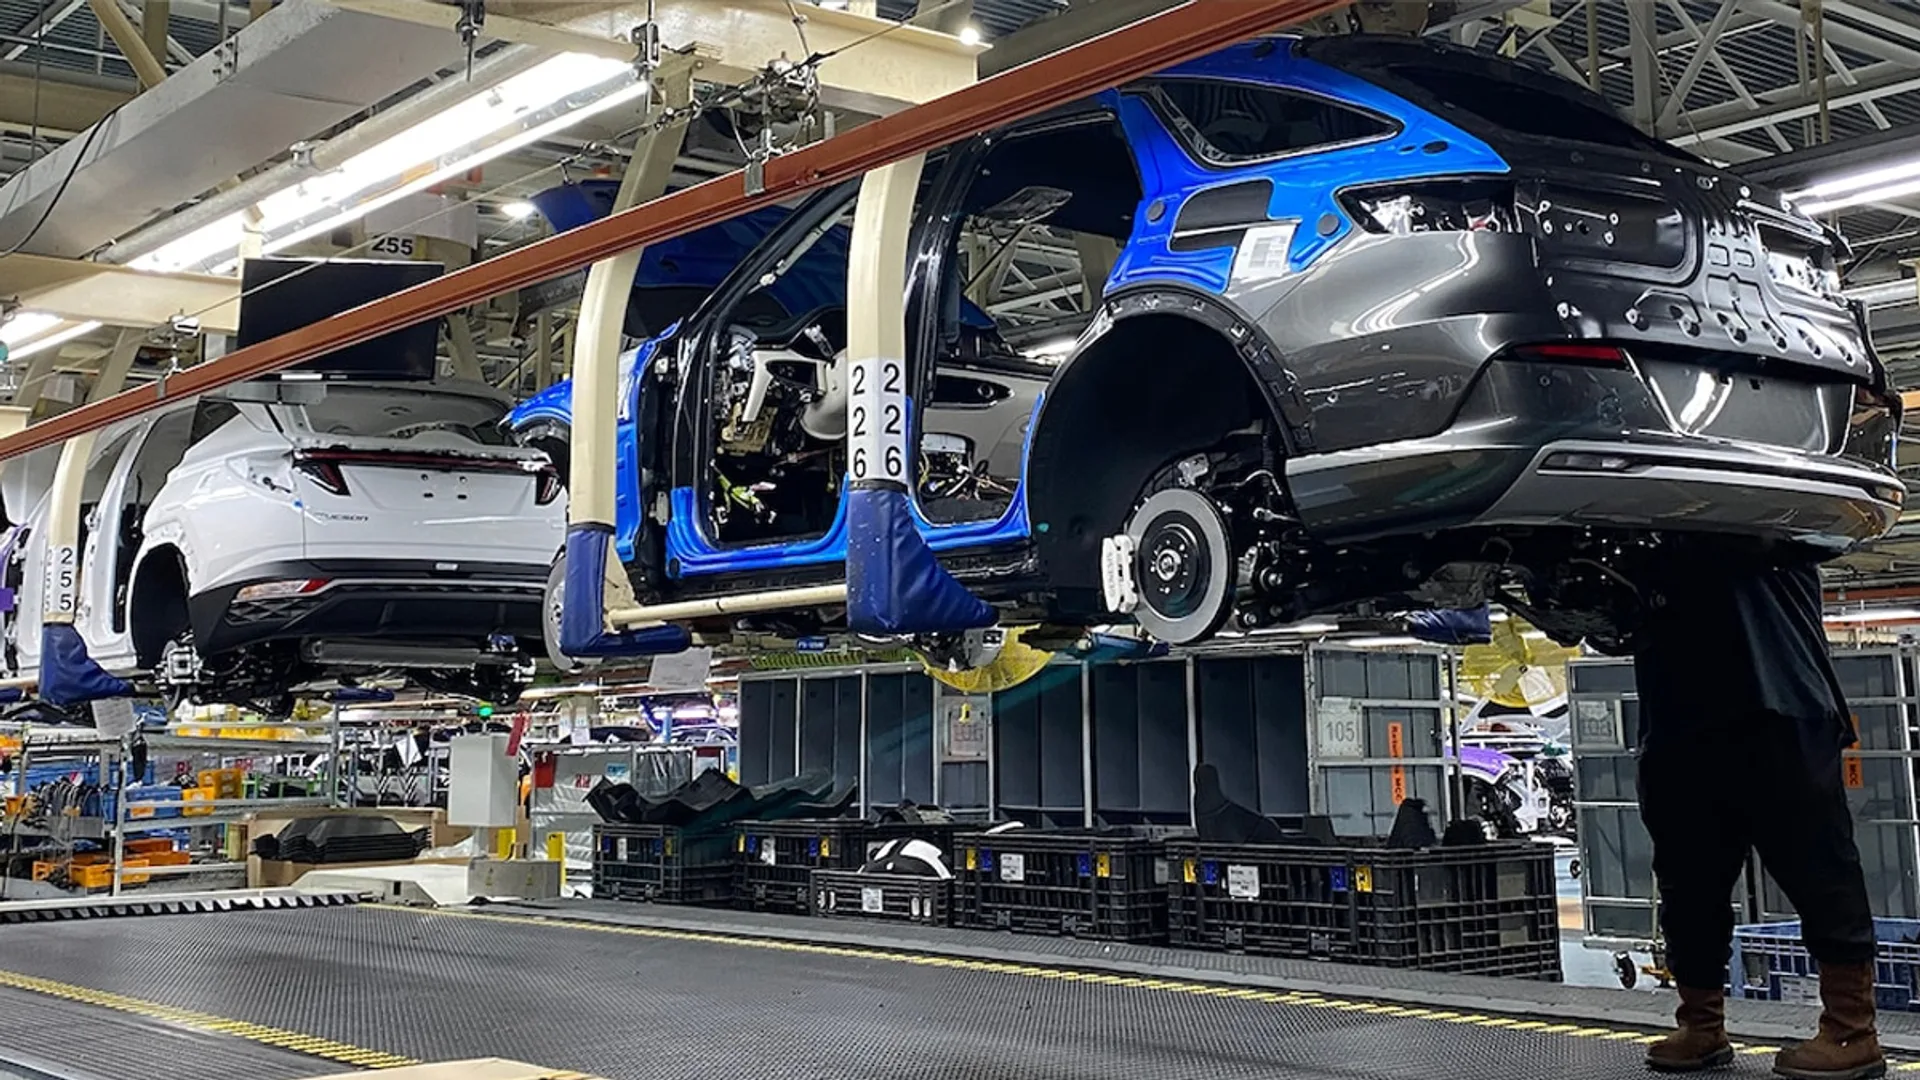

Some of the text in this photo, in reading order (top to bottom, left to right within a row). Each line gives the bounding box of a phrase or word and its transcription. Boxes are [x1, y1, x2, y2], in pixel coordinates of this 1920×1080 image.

[370, 232, 413, 255] 255
[852, 364, 866, 478] 226
[883, 363, 902, 477] 226
[60, 547, 73, 611] 255
[1326, 721, 1356, 742] 105
